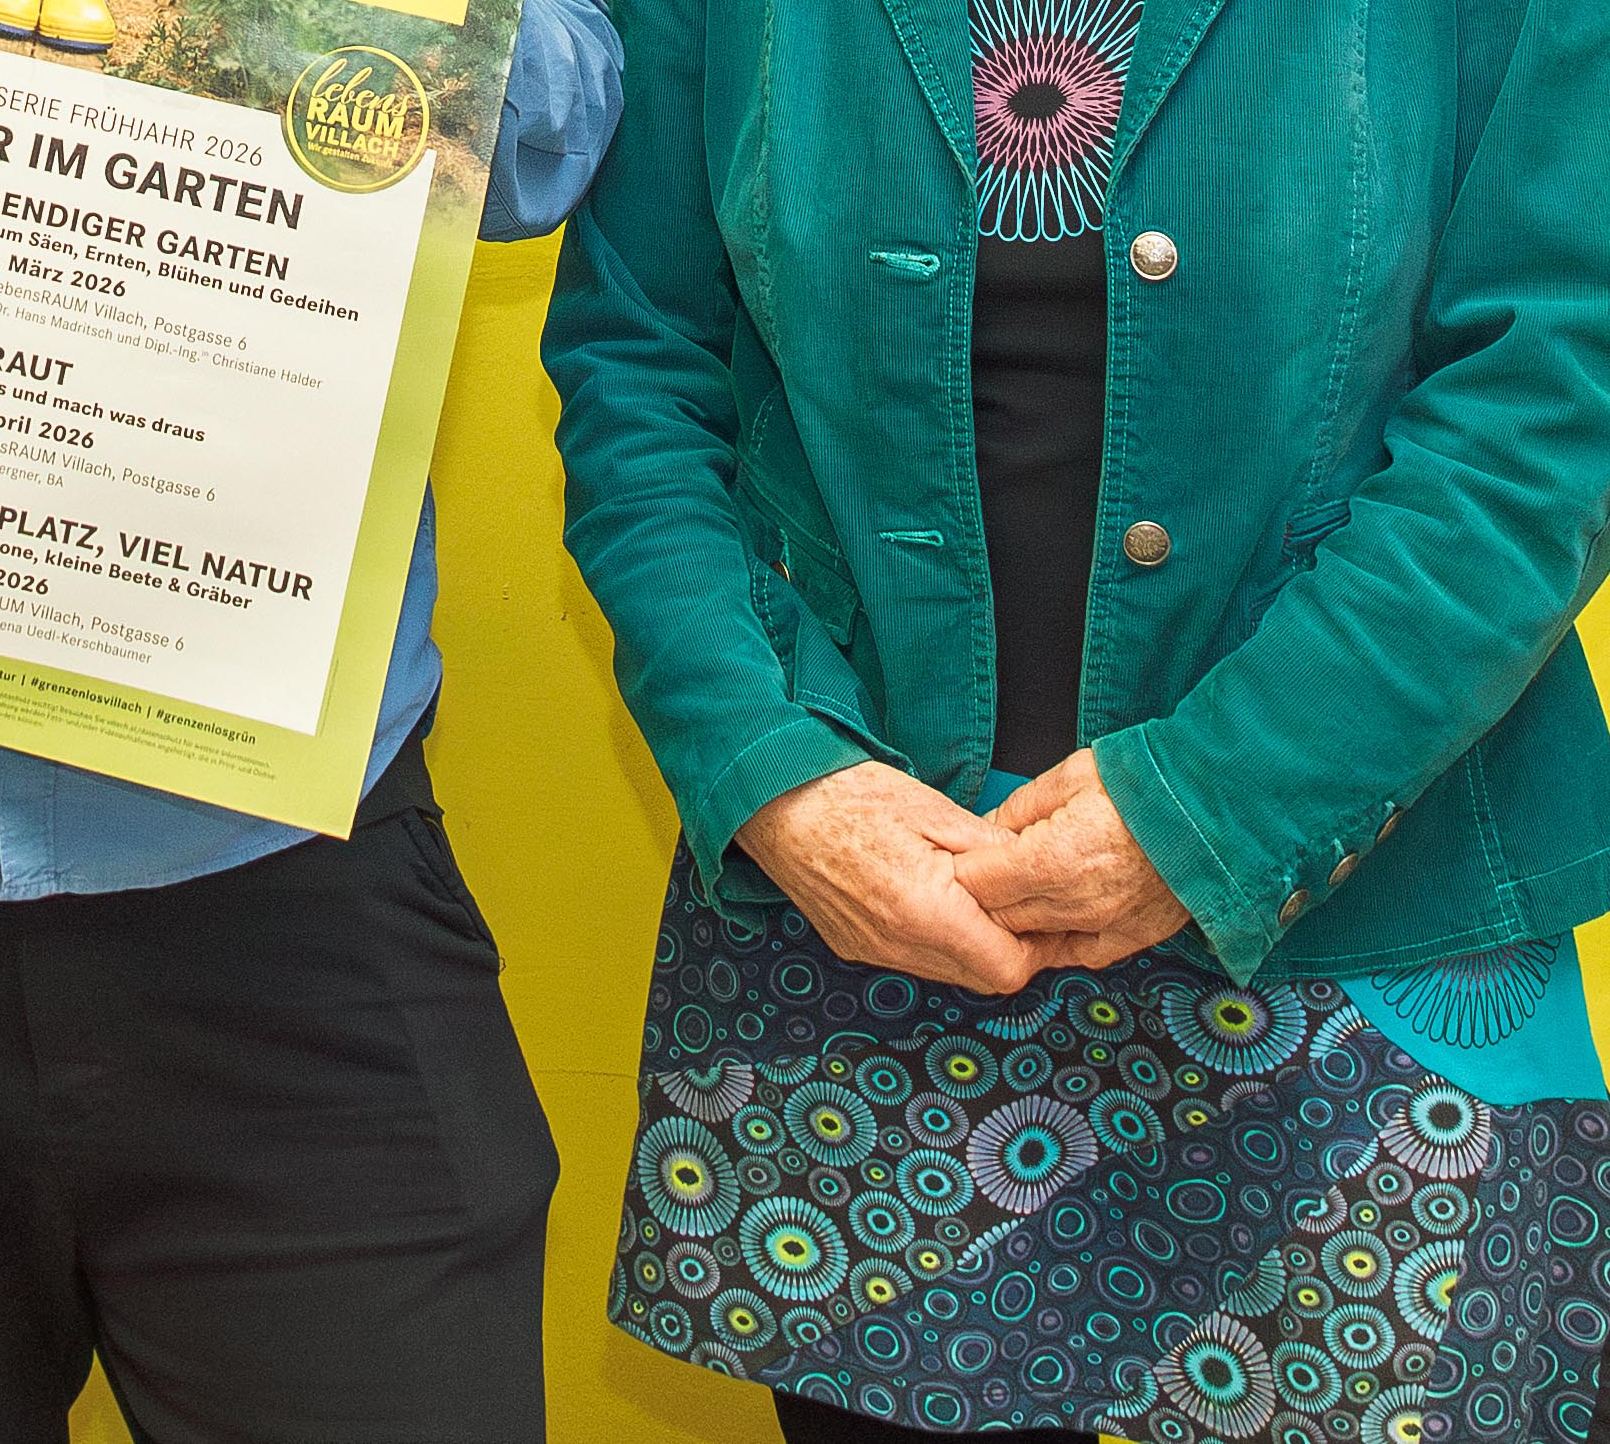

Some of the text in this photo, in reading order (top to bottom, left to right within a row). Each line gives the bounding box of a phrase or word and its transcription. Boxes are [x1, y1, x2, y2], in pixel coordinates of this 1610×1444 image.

[311, 57, 411, 118] lebens
[69, 103, 195, 152] FRÜHJAHR
[204, 135, 262, 167] 2026
[305, 121, 400, 159] VILLACH
[306, 96, 405, 140] RAUM
[28, 132, 90, 180] IM
[104, 152, 304, 231] GARTEN
[7, 254, 64, 284] März
[70, 270, 126, 298] 2026
[28, 231, 79, 261] Säen,
[84, 244, 151, 278] Ernten,
[157, 261, 223, 290] Blühen
[228, 281, 265, 300] und
[269, 287, 359, 322] Gedeihen
[156, 229, 290, 282] GARTEN
[94, 301, 148, 331] Villach,
[153, 316, 233, 348] Postgasse
[237, 336, 247, 351] 6
[12, 387, 48, 406] und
[52, 396, 104, 419] mach
[109, 410, 147, 429] was
[151, 417, 206, 442] draus
[37, 421, 94, 449] 2026
[46, 471, 66, 488] BA
[58, 451, 118, 482] Villach,
[122, 466, 202, 501] Postgasse
[204, 487, 216, 504] 6
[44, 548, 103, 575] kleine
[108, 562, 163, 589] Beete
[167, 577, 181, 594] &
[186, 581, 253, 609] Gräber
[119, 531, 190, 572] VIEL
[200, 551, 313, 602] NATUR
[27, 600, 88, 635] Villach,
[88, 615, 171, 650] Postgasse
[174, 636, 184, 652] 6
[29, 674, 145, 715] #grenzenlosvillach
[156, 704, 256, 745] #grenzenlosgrün
